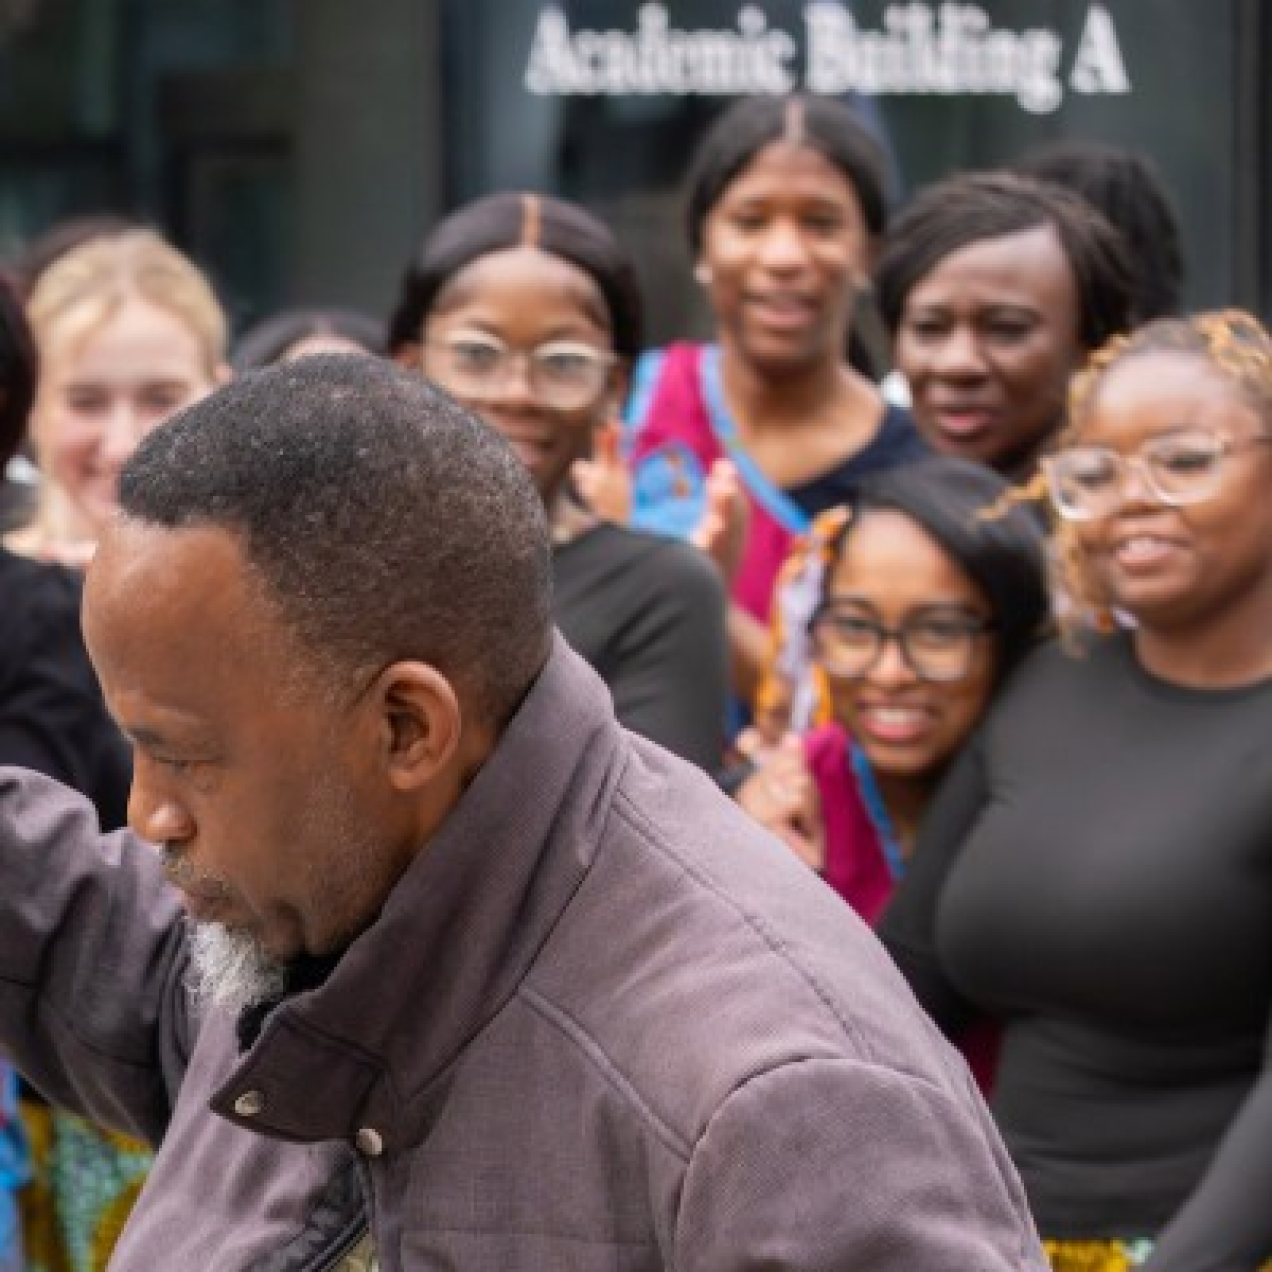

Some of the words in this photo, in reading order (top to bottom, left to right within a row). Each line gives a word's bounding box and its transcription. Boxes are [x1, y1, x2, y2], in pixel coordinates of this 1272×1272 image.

[524, 3, 794, 94] Academic
[804, 1, 1061, 113] Building
[1069, 4, 1131, 94] A
